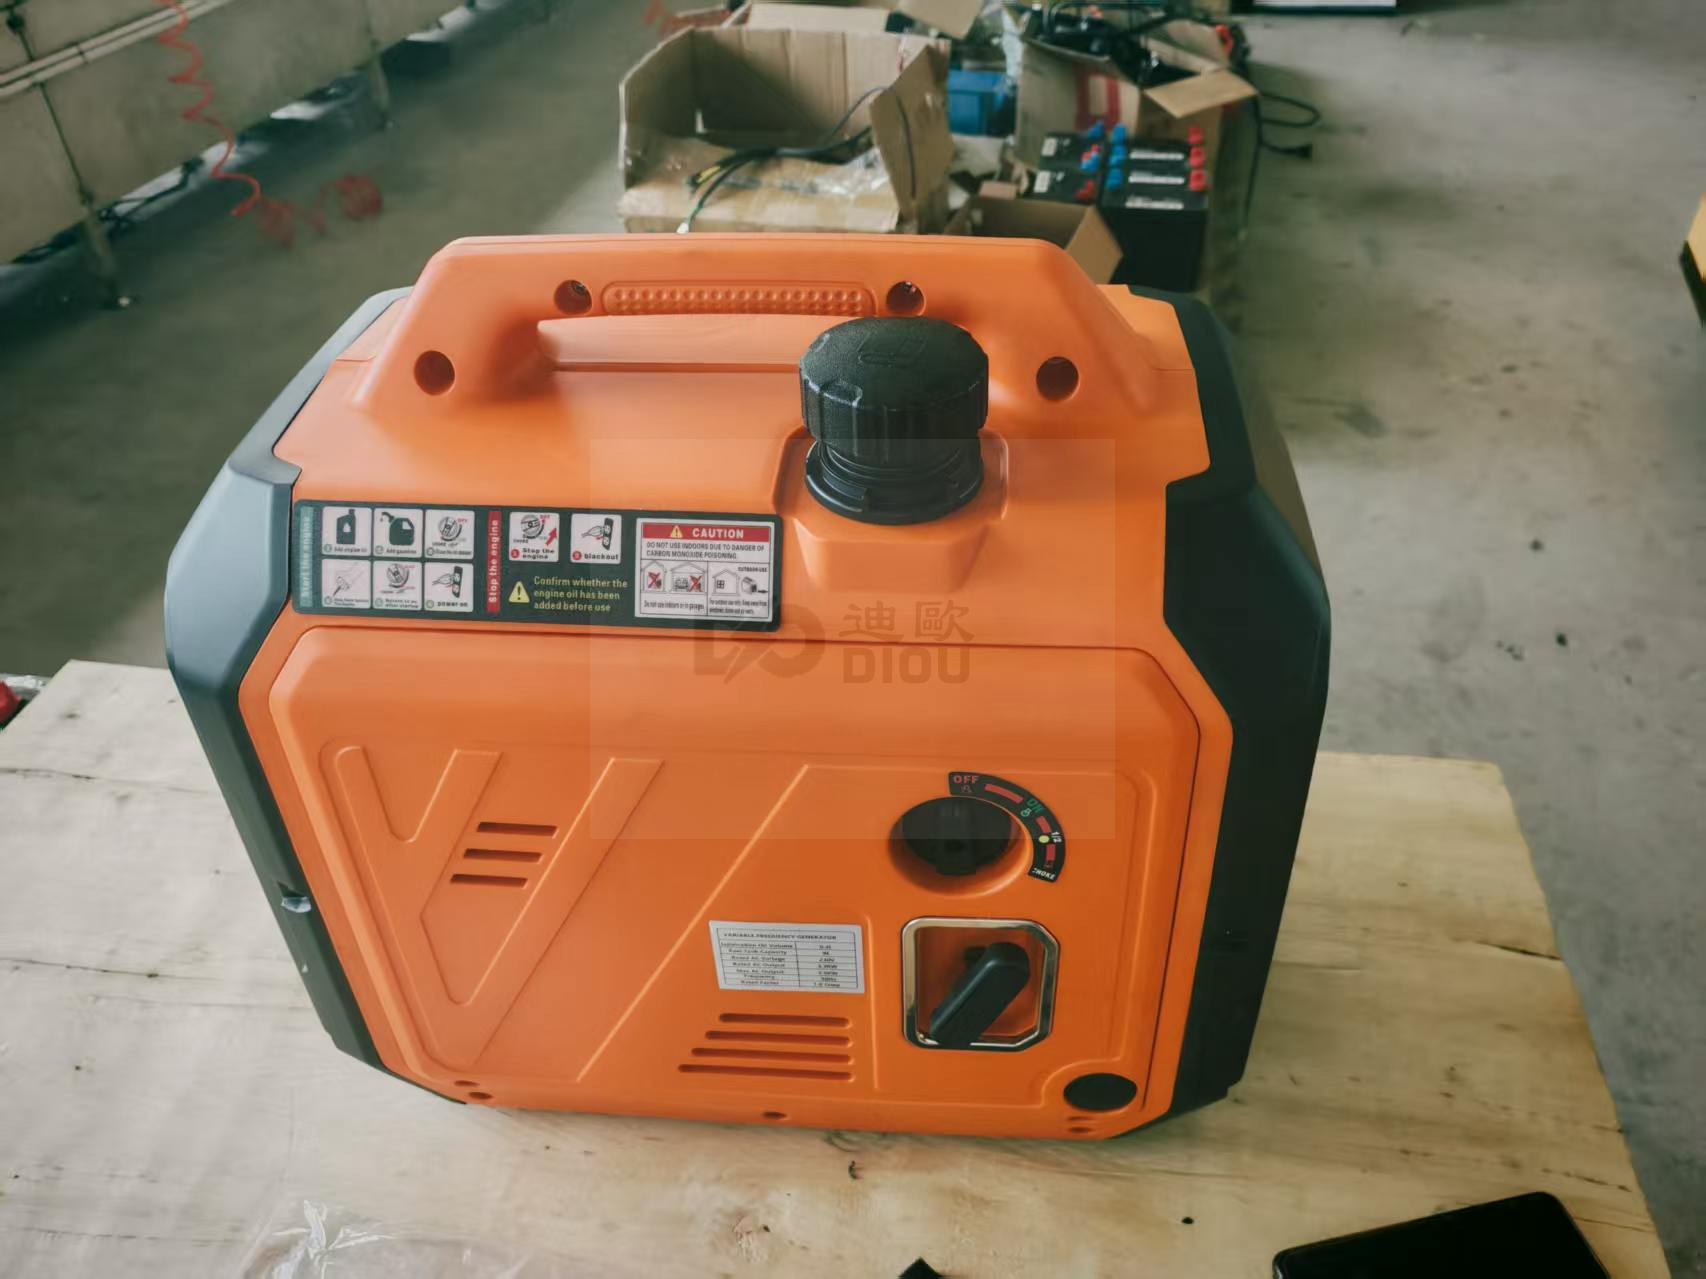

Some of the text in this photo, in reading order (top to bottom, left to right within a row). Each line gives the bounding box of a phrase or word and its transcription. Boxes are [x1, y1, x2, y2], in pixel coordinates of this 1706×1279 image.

[692, 527, 744, 539] CAUTION
[488, 520, 500, 602] Stop the engine
[534, 576, 628, 588] Confirm whether the
[534, 590, 620, 600] engine oil has been
[534, 601, 611, 611] added before use
[953, 775, 979, 784] OFF
[1027, 798, 1044, 813] ON
